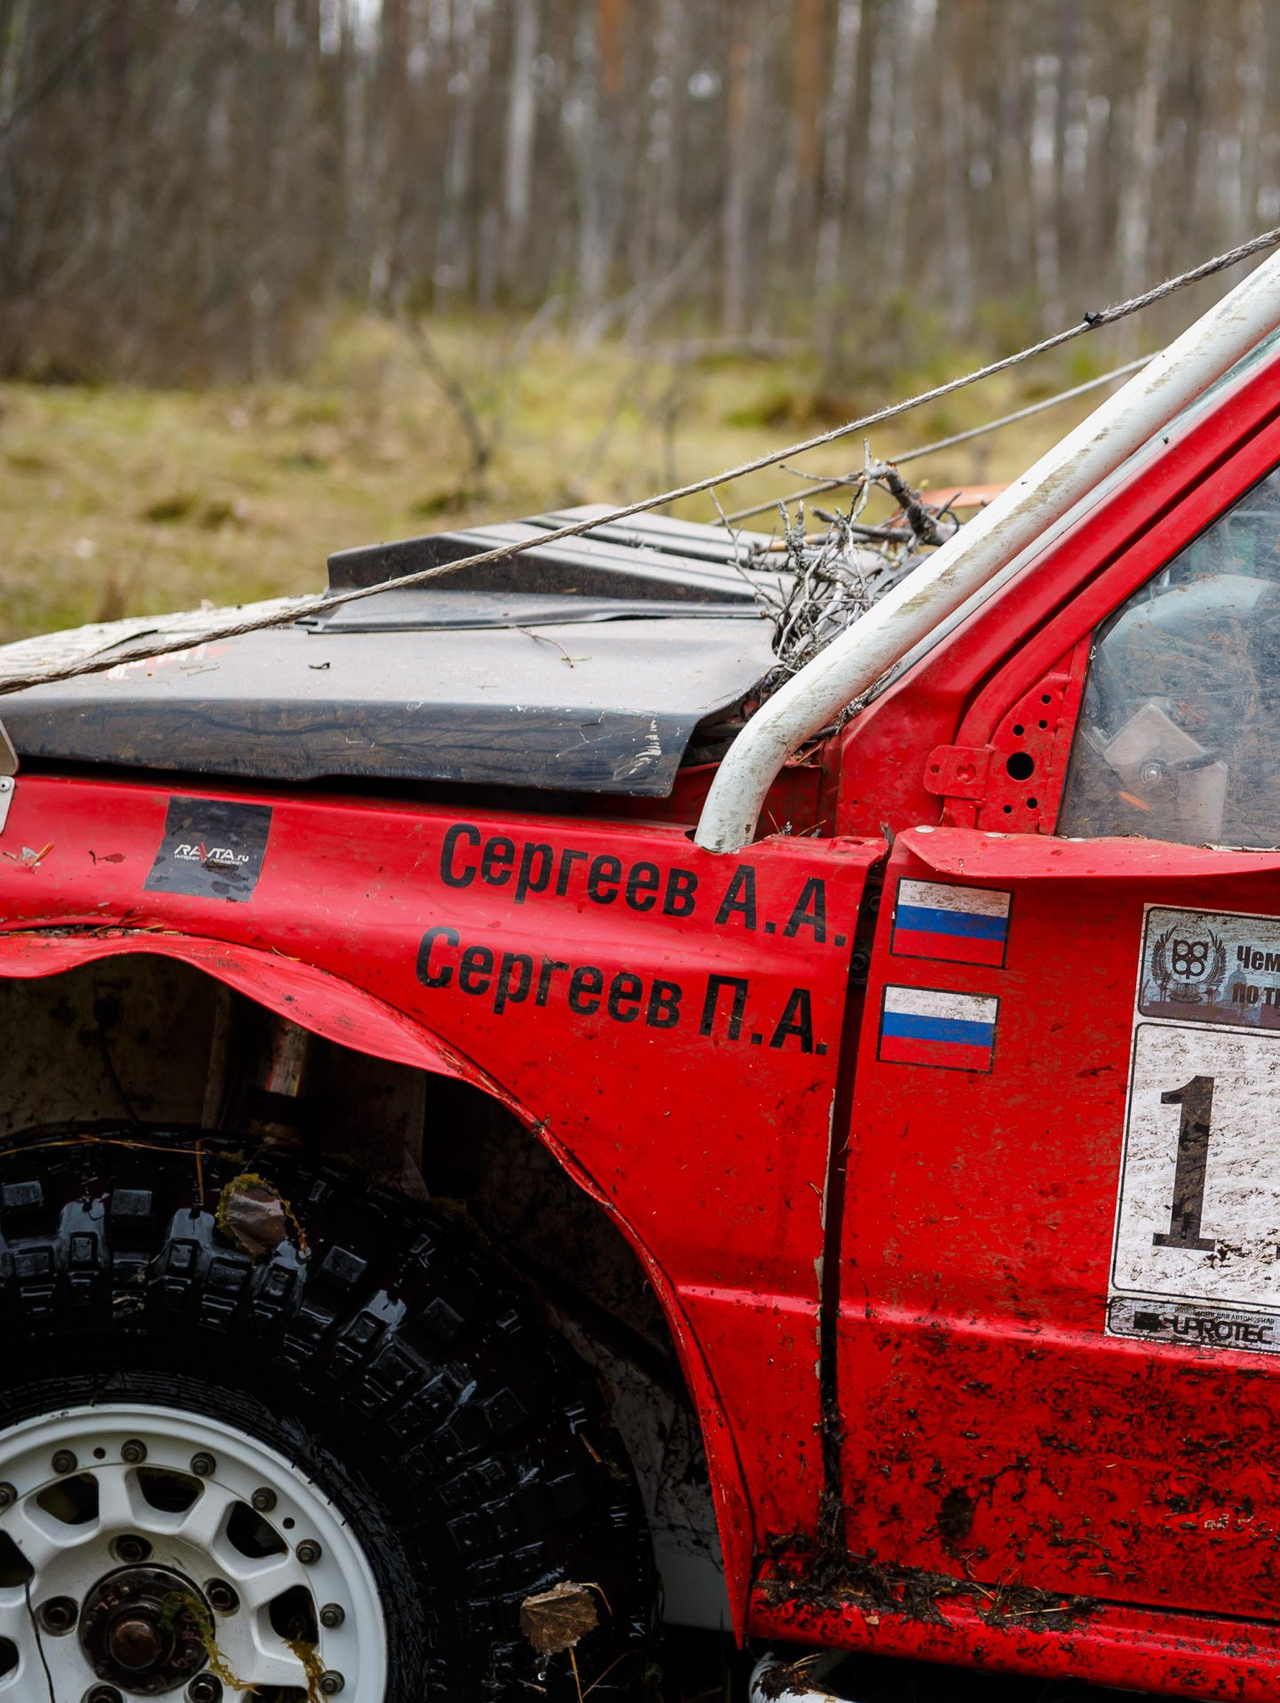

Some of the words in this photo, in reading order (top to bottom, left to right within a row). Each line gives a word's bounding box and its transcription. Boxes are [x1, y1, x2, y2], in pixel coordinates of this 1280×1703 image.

[440, 823, 699, 918] Сергеев
[714, 864, 847, 947] А.А.
[415, 926, 683, 1029] Сергеев
[700, 973, 828, 1056] П.А.
[1231, 982, 1259, 1005] по
